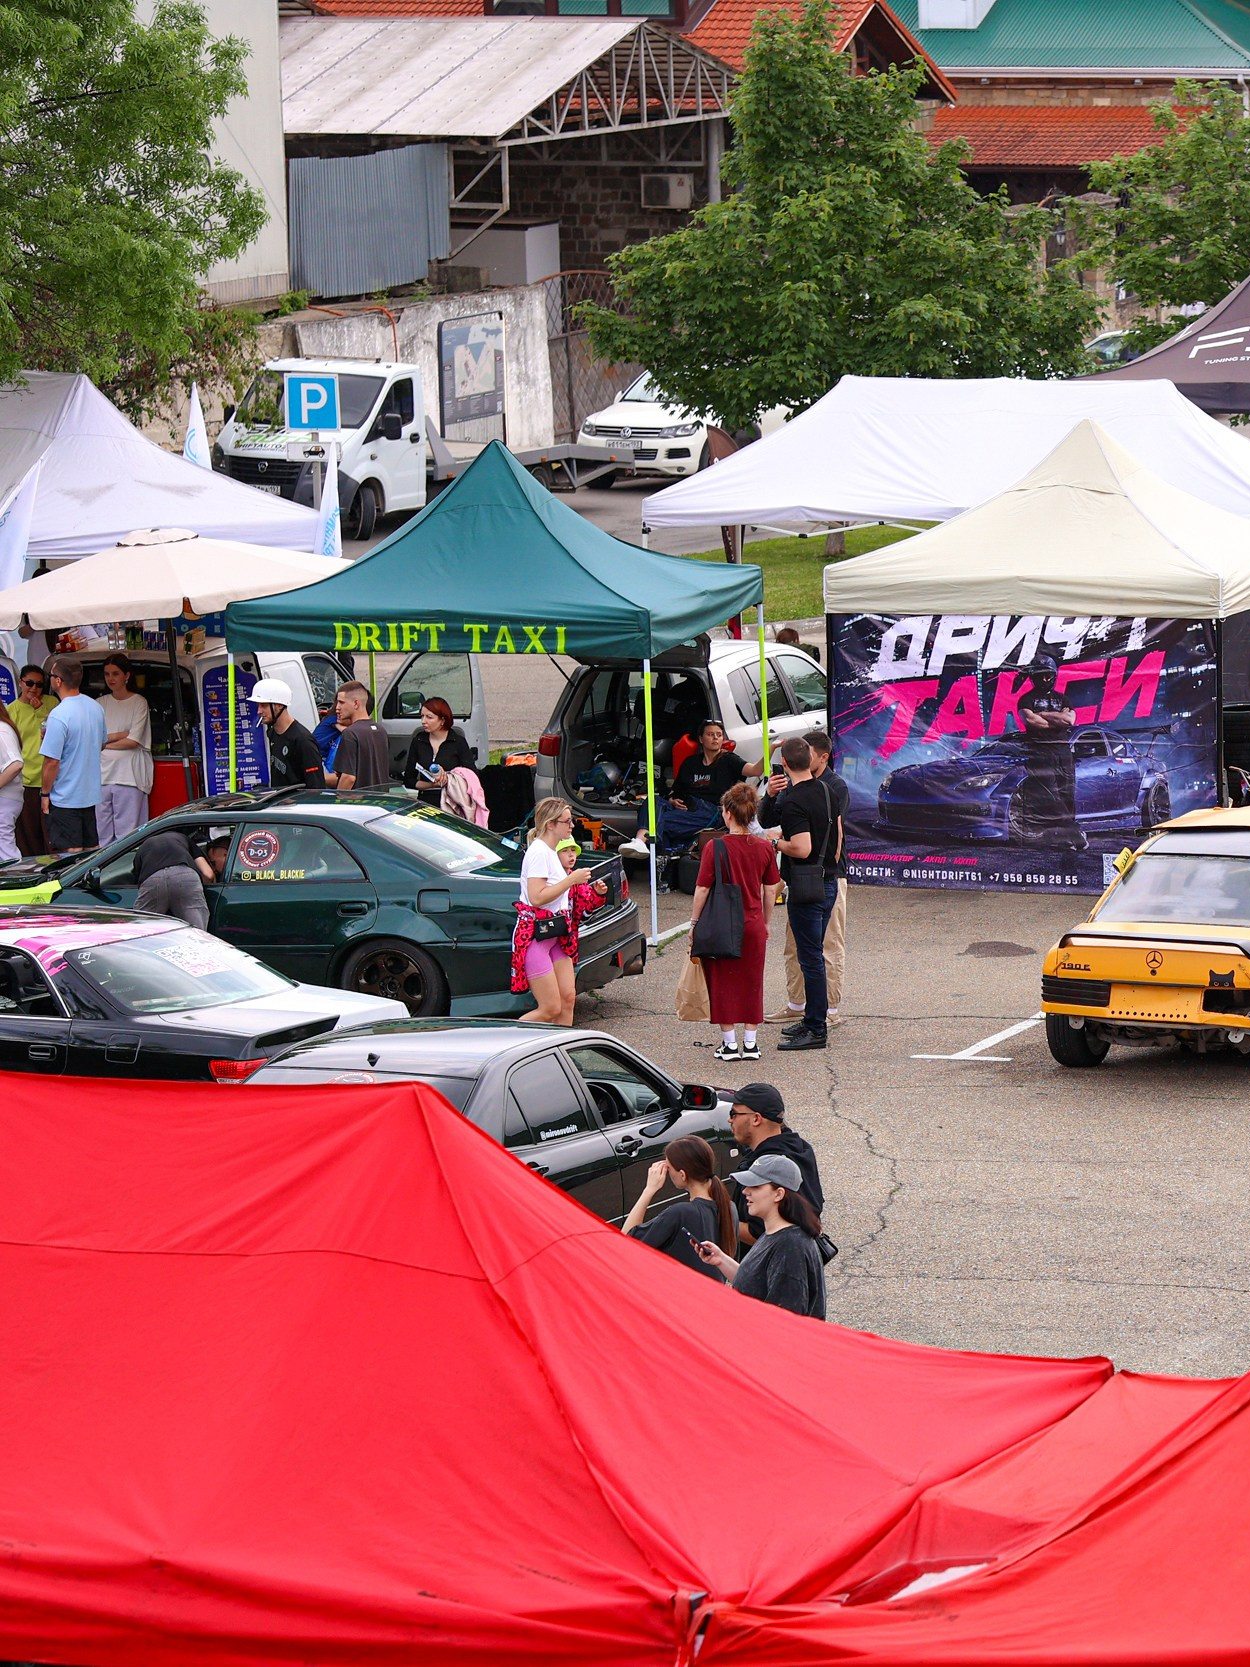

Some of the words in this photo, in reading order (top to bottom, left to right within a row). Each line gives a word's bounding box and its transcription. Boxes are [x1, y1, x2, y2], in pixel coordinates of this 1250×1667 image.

[1203, 356, 1239, 364] TUNING
[300, 382, 328, 424] P
[333, 622, 446, 652] DRIFT
[463, 624, 567, 654] TAXI
[870, 650, 1167, 761] ТАКСИ
[847, 853, 914, 863] ВТОИНСТРУКТОР
[922, 855, 947, 864] АКПП
[902, 869, 982, 882] @NIGHTDRIFT61
[989, 872, 1000, 882] +7
[1003, 873, 1023, 883] 950
[1025, 874, 1046, 884] 850
[1048, 875, 1062, 884] 28
[1065, 875, 1078, 885] 55
